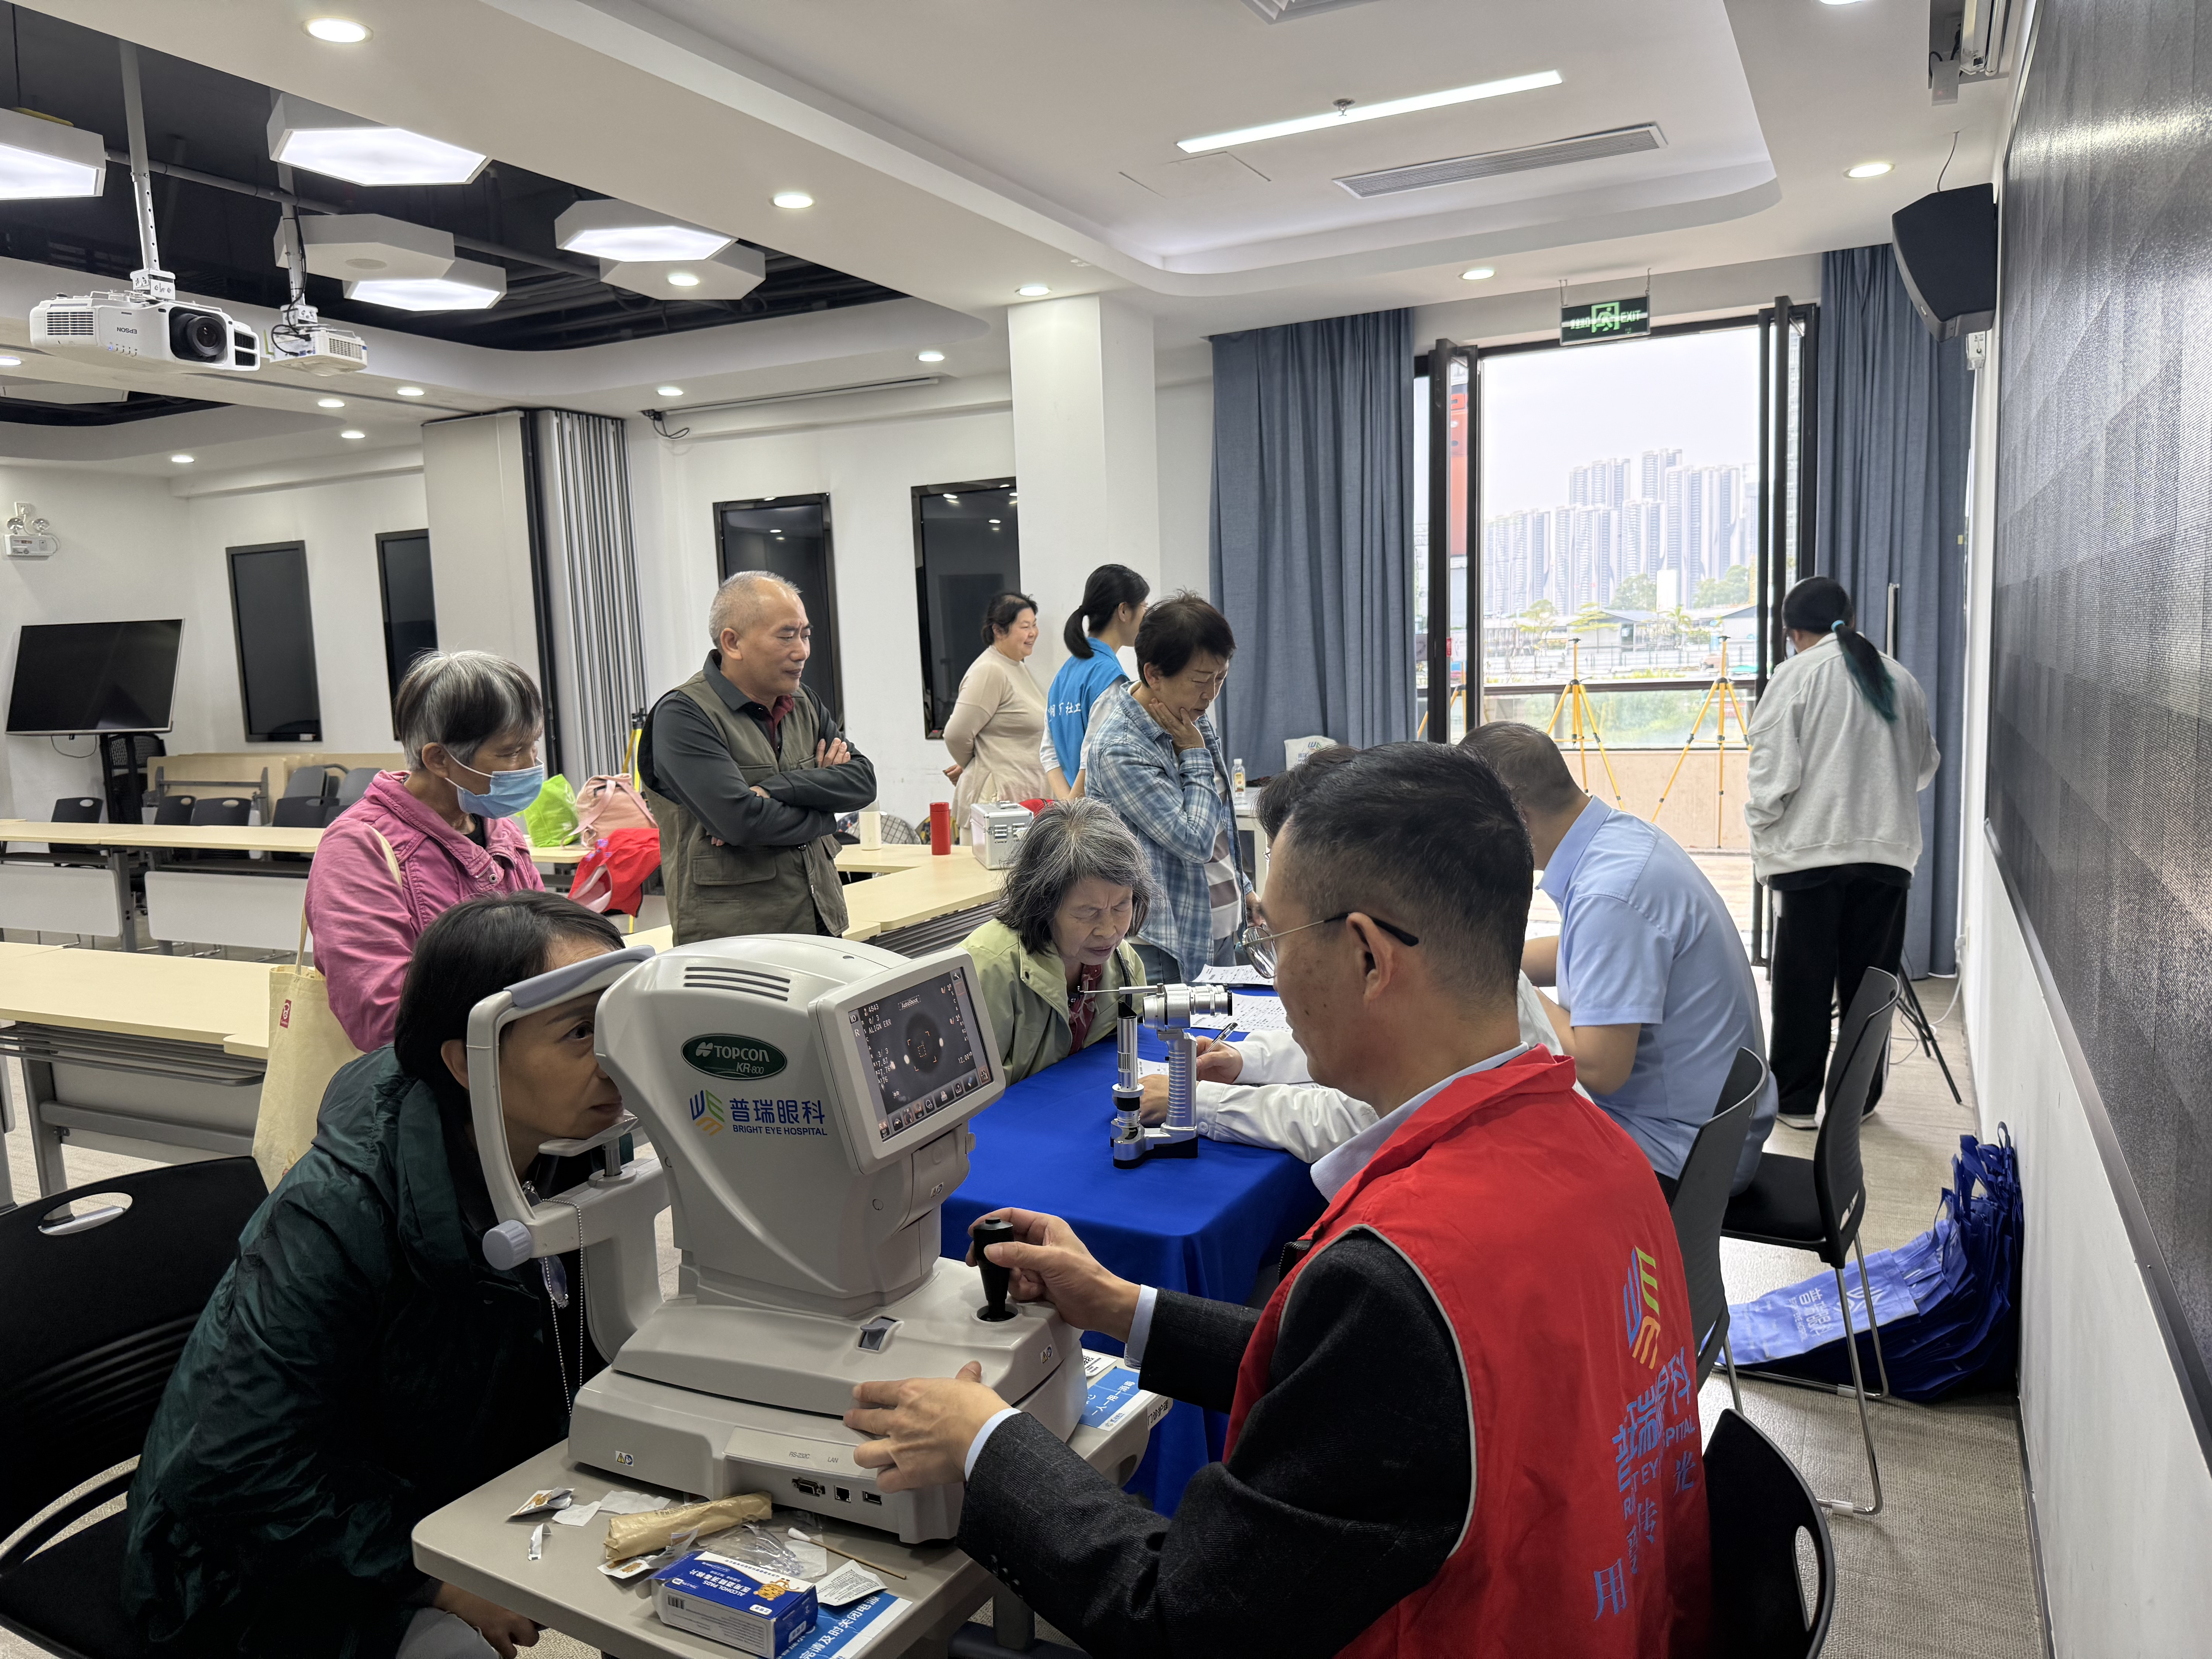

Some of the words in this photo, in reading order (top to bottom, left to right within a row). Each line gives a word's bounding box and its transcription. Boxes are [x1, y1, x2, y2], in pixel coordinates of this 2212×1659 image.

[1620, 310, 1641, 323] EXIT
[854, 1029, 860, 1037] R
[868, 1024, 882, 1034] ALIGN
[883, 1019, 892, 1028] ERR
[713, 1045, 770, 1062] TOPCON
[736, 1062, 764, 1075] KR-800
[729, 1098, 825, 1124] 普瑞眼科
[733, 1125, 763, 1134] BRIGHT
[765, 1126, 782, 1135] EYE
[784, 1127, 828, 1136] HOSPITAL
[1092, 1381, 1135, 1415] 一人一用一消毒
[1665, 1415, 1695, 1447] PITAL
[702, 1580, 718, 1589] PADS
[718, 1586, 746, 1597] ALCOHOL
[799, 1595, 881, 1659] 完请及时关闭电源
